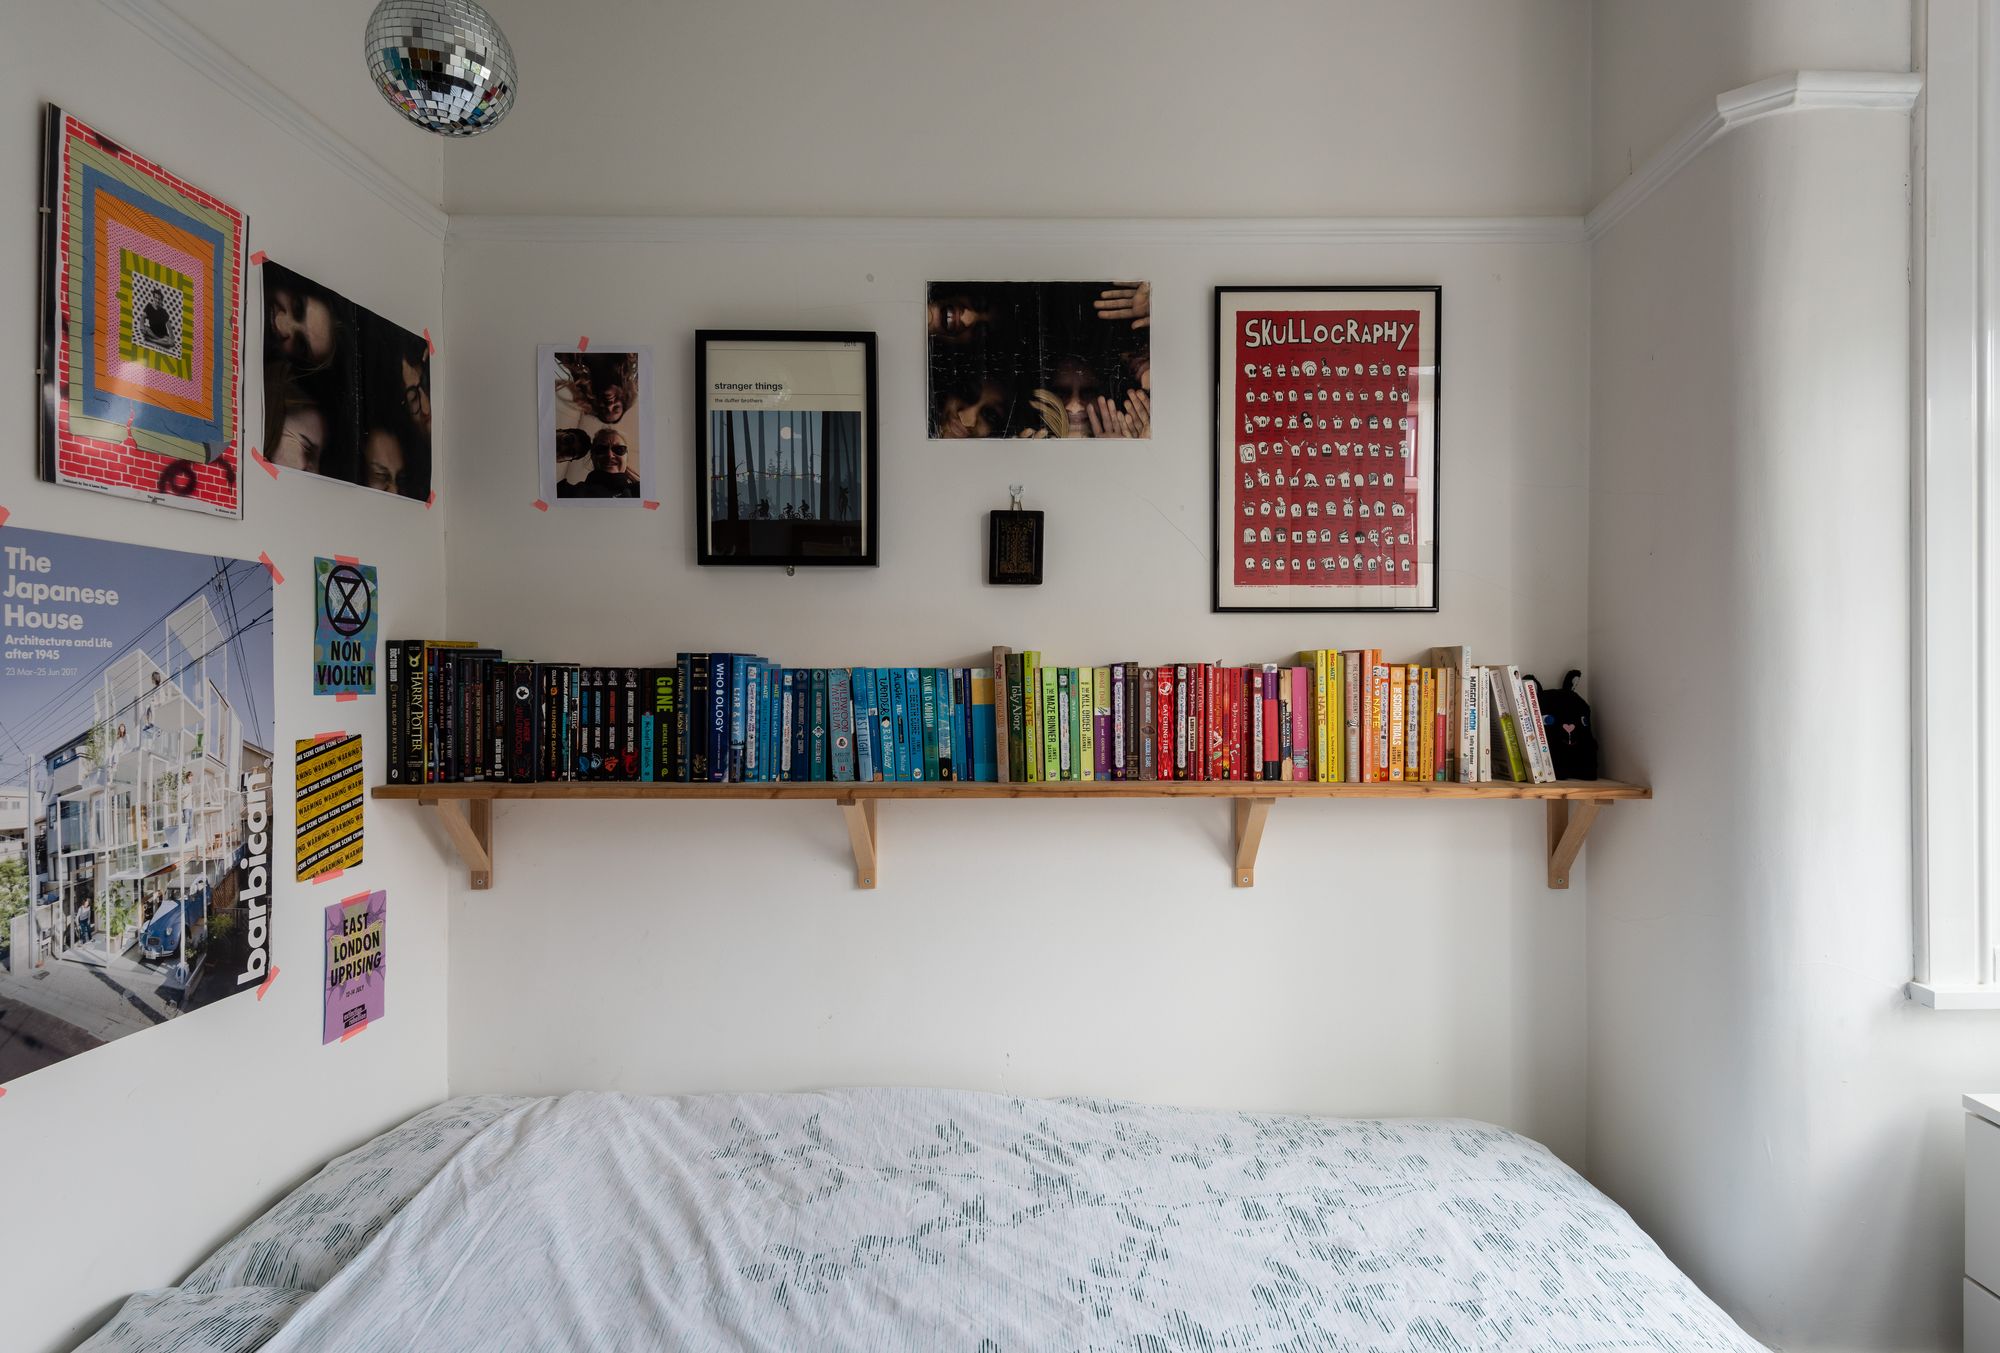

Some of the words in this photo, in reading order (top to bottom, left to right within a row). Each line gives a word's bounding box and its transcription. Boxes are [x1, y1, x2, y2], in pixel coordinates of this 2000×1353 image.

[1244, 318, 1414, 351] SKULLOGRAPHY
[714, 382, 752, 391] stranger
[755, 382, 783, 391] things
[4, 546, 51, 573] The
[3, 574, 119, 605] Japanese
[4, 604, 84, 630] House
[5, 635, 72, 647] Architecture
[74, 638, 94, 647] and
[95, 638, 112, 648] Life
[5, 649, 33, 659] after
[36, 650, 60, 660] 1945
[331, 641, 361, 661] NON
[62, 668, 77, 676] 2017
[317, 665, 373, 685] VIOLENT
[411, 672, 424, 708] HARRY
[657, 677, 672, 712] GONE
[1011, 685, 1022, 703] Toby
[1082, 694, 1090, 708] KILL
[832, 684, 840, 732] IMPERIUM
[840, 680, 849, 732] WILDWOOD
[1013, 704, 1022, 731] Alone
[1046, 696, 1055, 713] MAZE
[1393, 694, 1402, 720] SCORCH
[856, 707, 867, 730] FIRST
[1047, 715, 1056, 743] RUNNER
[1082, 710, 1090, 732] ORDER
[1534, 708, 1546, 745] AUTOCORRECT!
[411, 712, 424, 752] POTTER
[1393, 722, 1402, 745] TRIALS
[858, 734, 868, 757] LIGHT
[298, 799, 322, 815] WARMING
[324, 788, 347, 803] WARMING
[307, 831, 330, 847] WARMING
[331, 818, 354, 833] WARMING
[237, 772, 268, 985] barbican
[343, 913, 369, 937] EAST
[334, 930, 380, 963] LONDON
[330, 952, 382, 987] UPRISING
